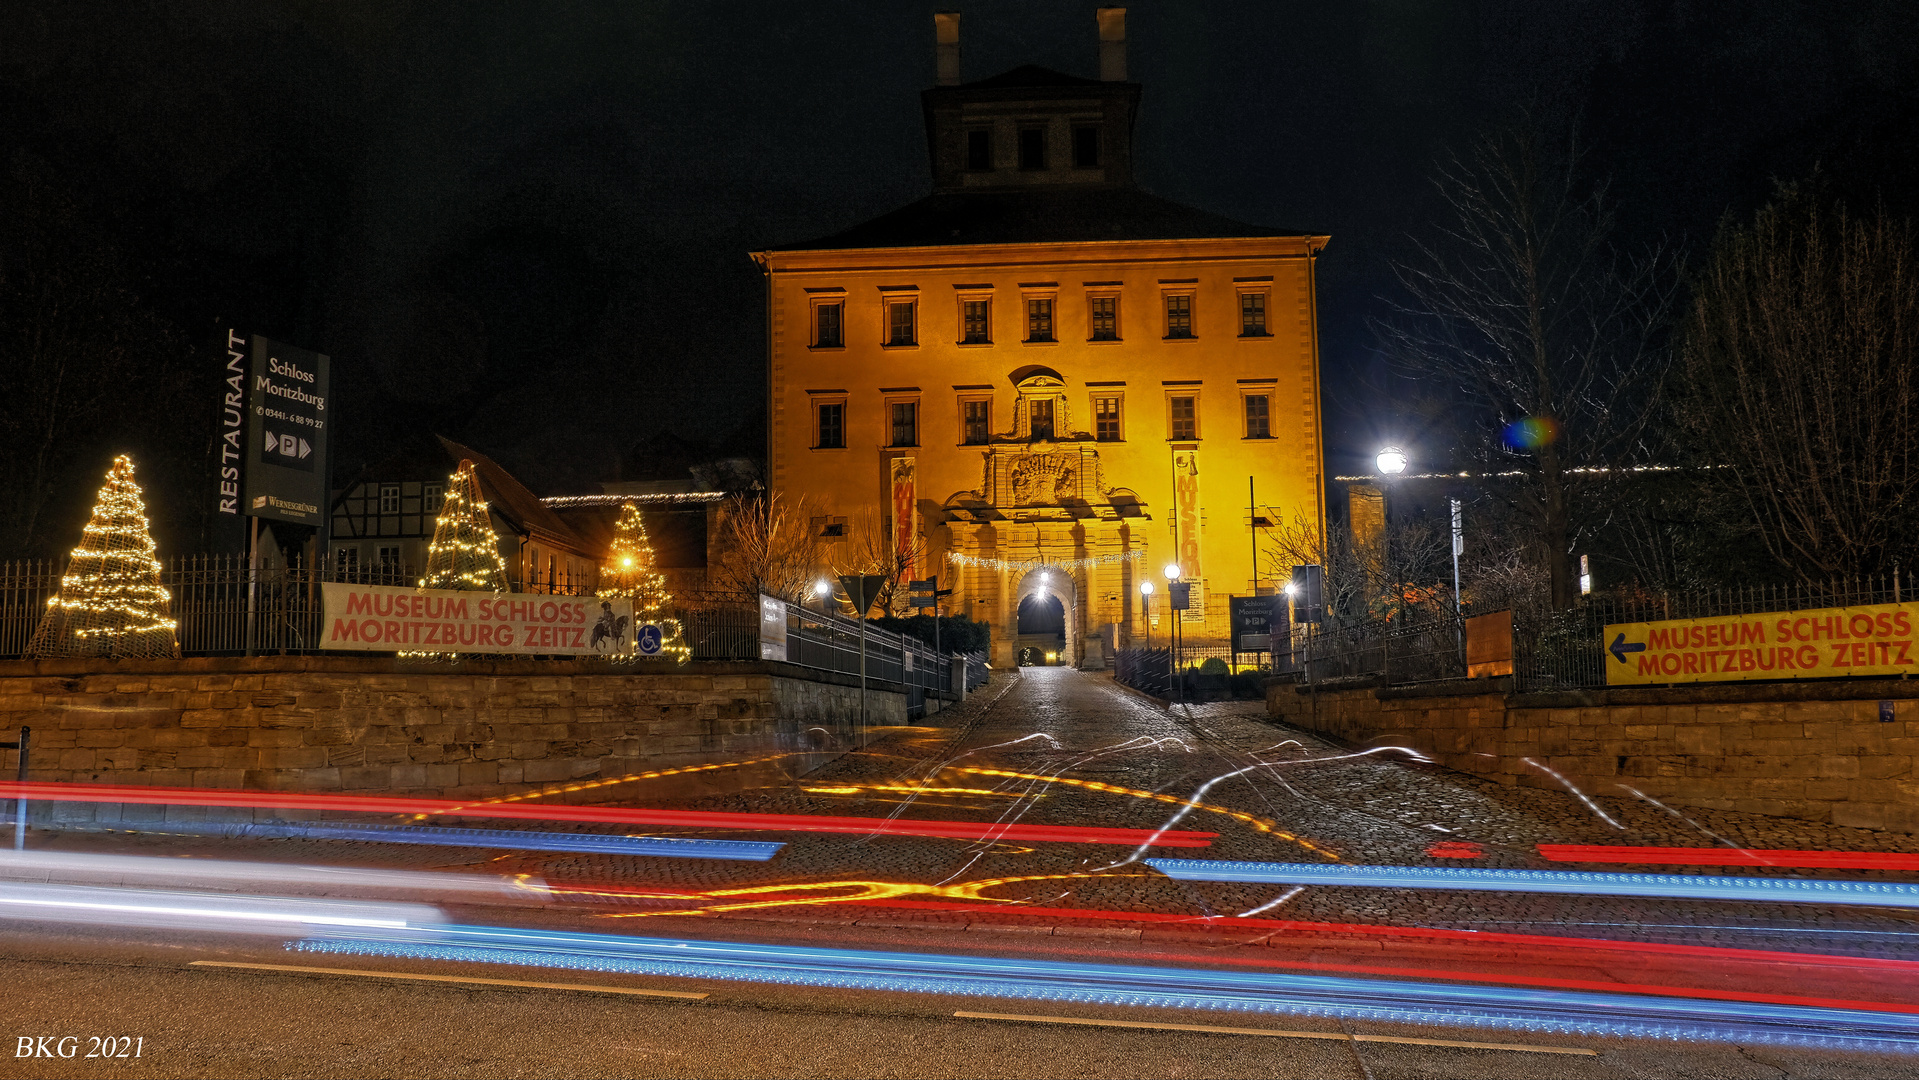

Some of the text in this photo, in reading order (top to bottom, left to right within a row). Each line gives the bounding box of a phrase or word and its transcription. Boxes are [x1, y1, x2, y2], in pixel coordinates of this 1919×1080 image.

[269, 357, 315, 384] Schloss
[255, 375, 325, 411] Moritzburg
[219, 328, 246, 515] RESTAURANT
[295, 415, 305, 425] 88
[305, 417, 314, 427] 99
[314, 419, 324, 429] 27
[268, 495, 318, 514] WERNESGRÜNER
[345, 592, 586, 624] MUSEUM SCHLOSS
[331, 618, 586, 648] MORITZBURG ZEITZ
[1647, 611, 1912, 651] MUSEUM SCHLOSS
[1637, 640, 1914, 677] MORITZBURG ZEITZ
